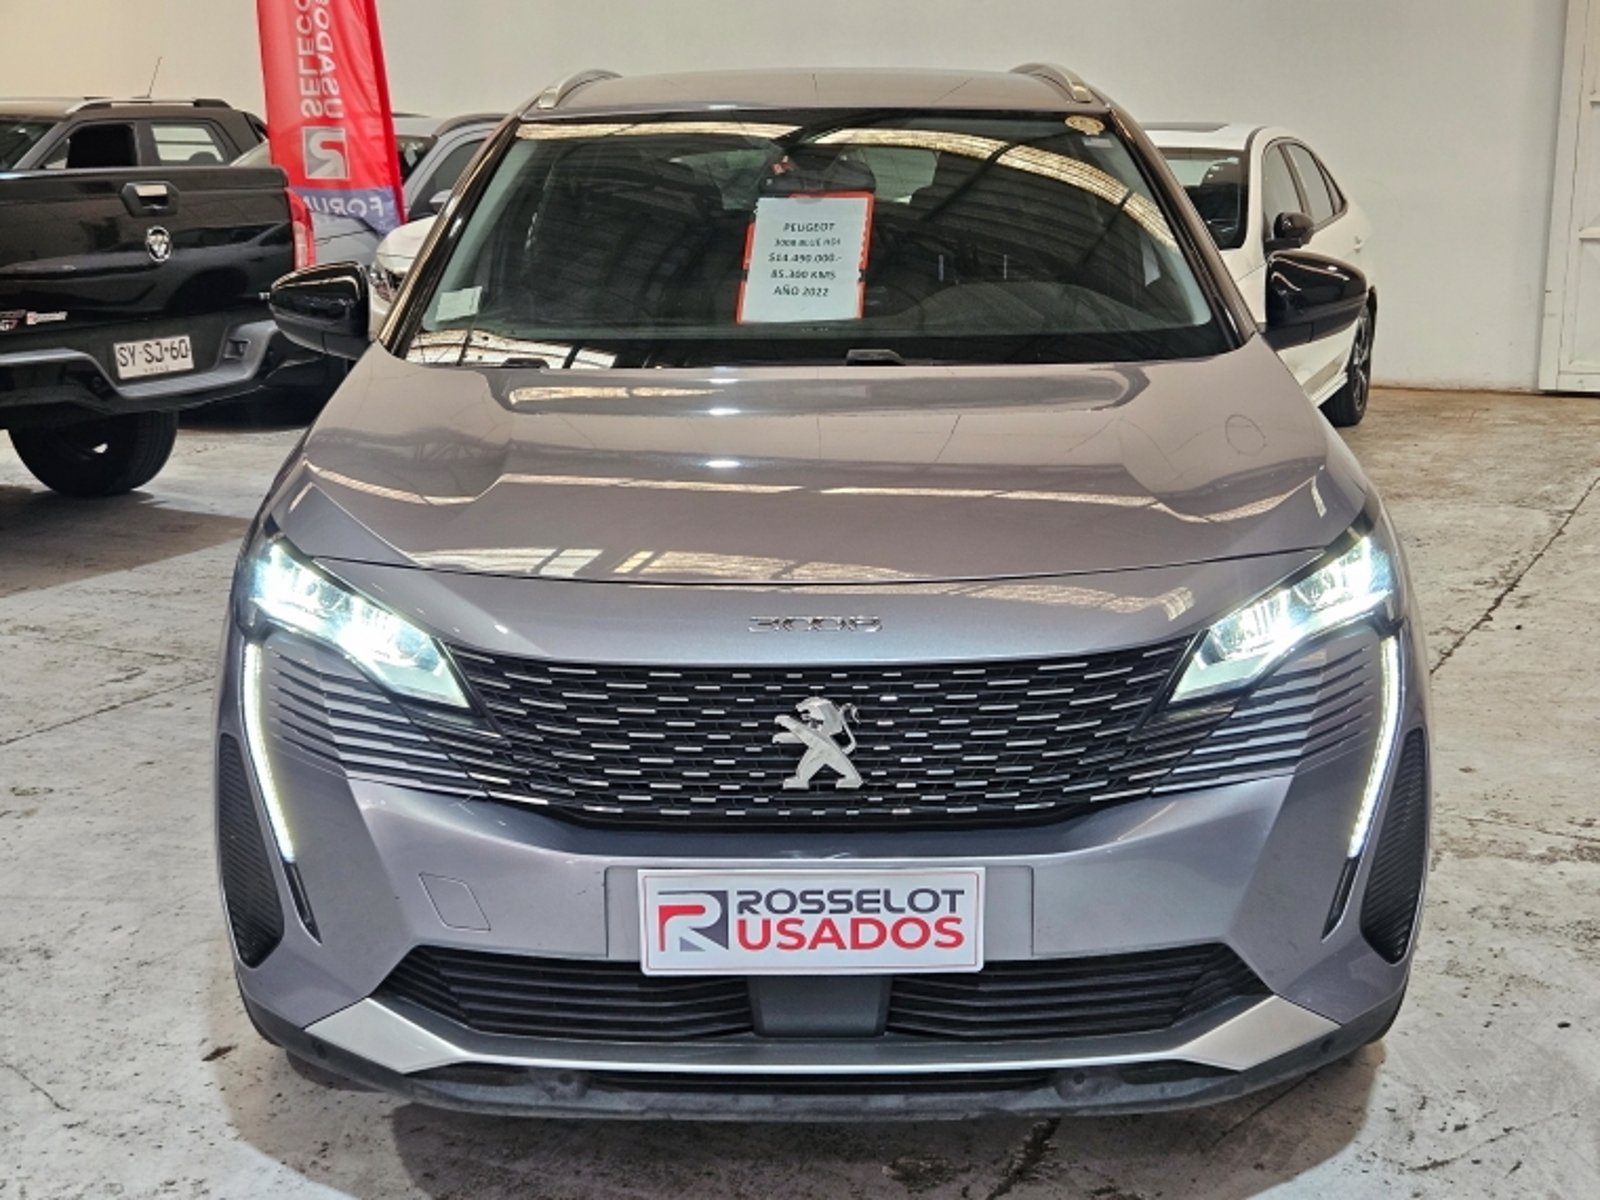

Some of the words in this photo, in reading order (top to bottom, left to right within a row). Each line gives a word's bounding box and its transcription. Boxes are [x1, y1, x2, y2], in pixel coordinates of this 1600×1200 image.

[783, 222, 836, 233] PEUGEOT
[772, 283, 800, 295] AÑO
[802, 286, 829, 297] 2022
[736, 888, 965, 915] ROSSELOT
[736, 916, 965, 951] USADOS
